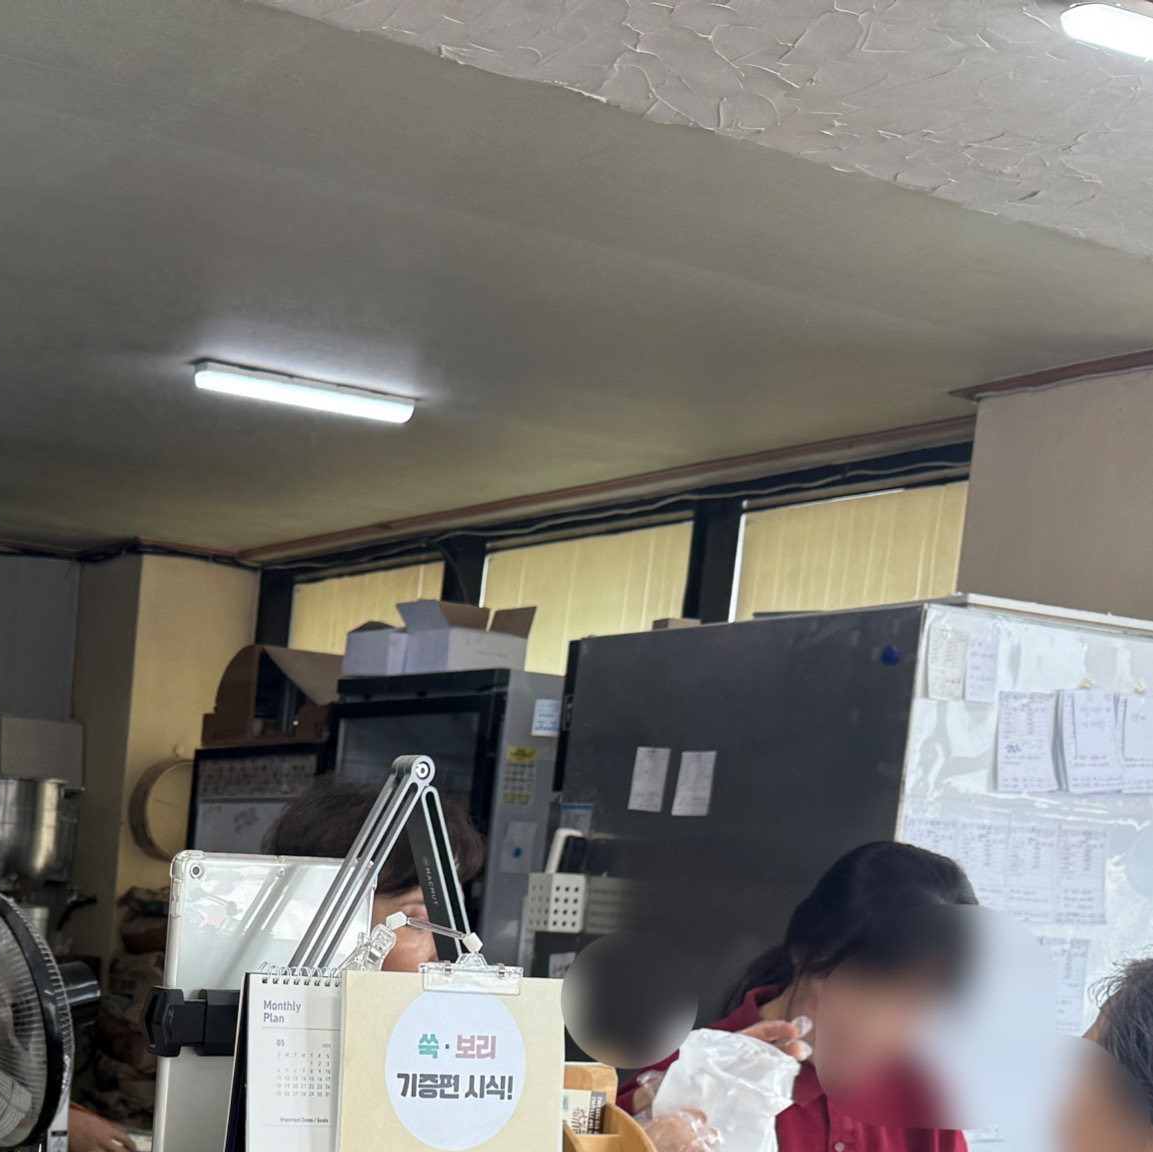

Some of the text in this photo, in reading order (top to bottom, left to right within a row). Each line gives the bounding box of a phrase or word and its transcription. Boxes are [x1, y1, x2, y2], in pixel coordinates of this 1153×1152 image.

[263, 1000, 301, 1013] Monthly
[263, 1012, 285, 1023] Plan
[418, 1034, 439, 1059] 쑥
[456, 1035, 496, 1059] 보리
[397, 1073, 513, 1100] 기증편 시식!
